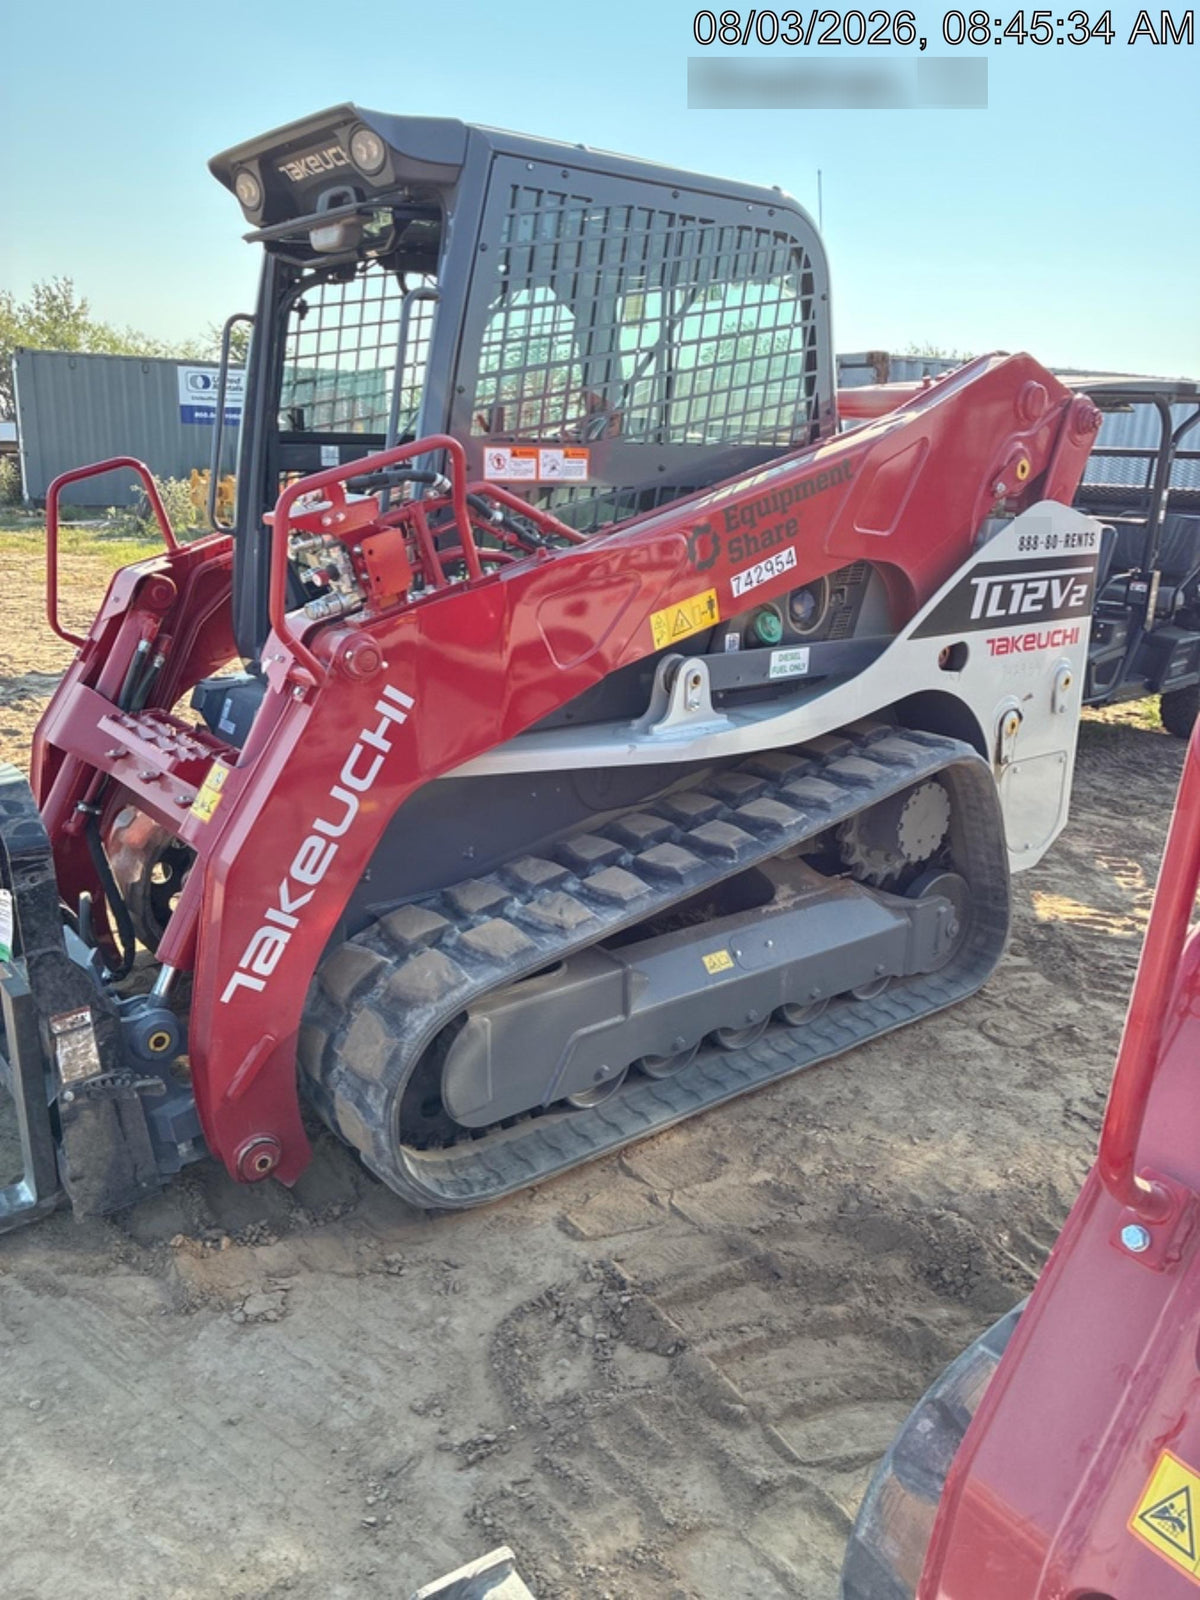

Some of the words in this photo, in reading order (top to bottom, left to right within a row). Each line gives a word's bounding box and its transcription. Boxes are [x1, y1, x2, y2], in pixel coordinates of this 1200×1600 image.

[722, 458, 855, 533] Equipment
[727, 517, 799, 564] Share
[1018, 532, 1096, 552] 888-80-RENTS
[732, 548, 796, 595] 742954
